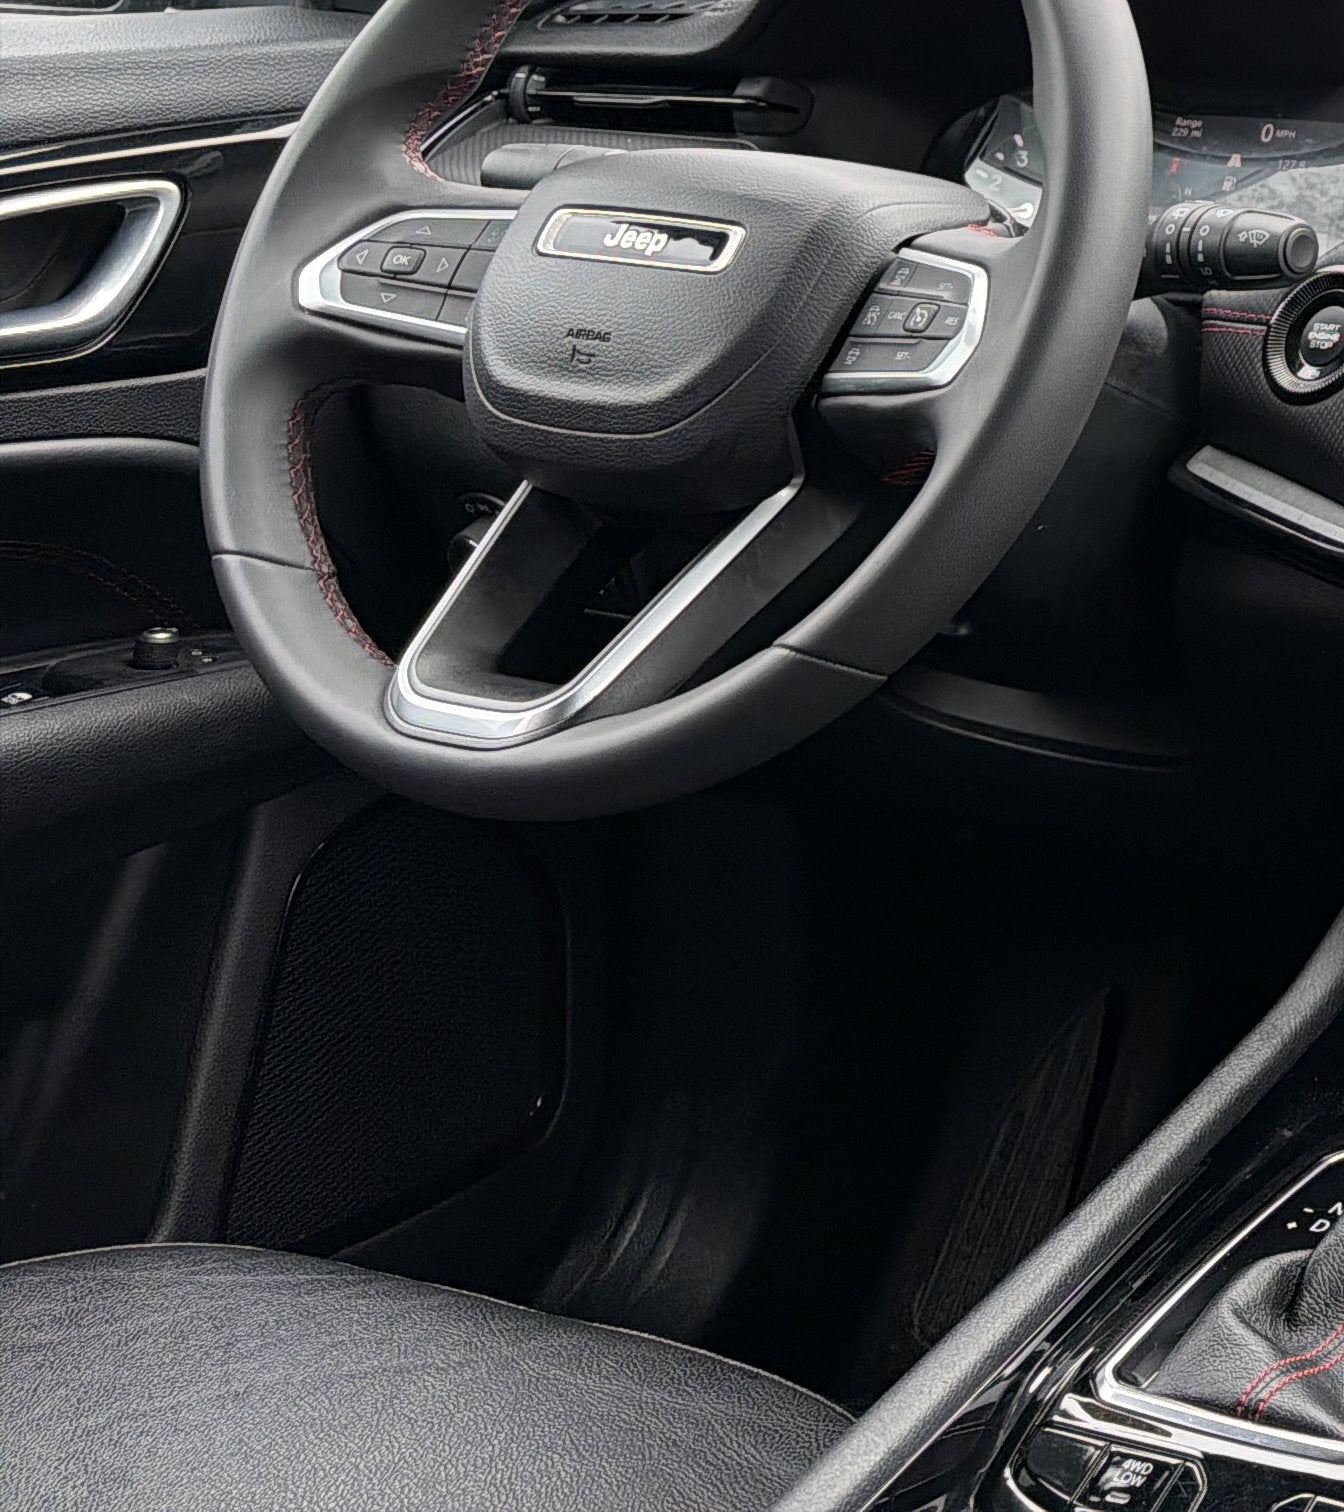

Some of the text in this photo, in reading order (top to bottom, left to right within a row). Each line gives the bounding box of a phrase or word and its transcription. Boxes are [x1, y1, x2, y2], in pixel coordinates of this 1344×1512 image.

[1174, 116, 1204, 129] Range
[1260, 122, 1298, 144] 0 MPH
[604, 224, 669, 256] Jeep
[392, 254, 411, 266] OK
[1313, 322, 1342, 331] START
[565, 328, 612, 342] AIRBAG
[1309, 339, 1336, 350] STOP
[1309, 1218, 1331, 1233] D
[1121, 1458, 1154, 1476] 4WD
[1112, 1472, 1148, 1488] LOW
